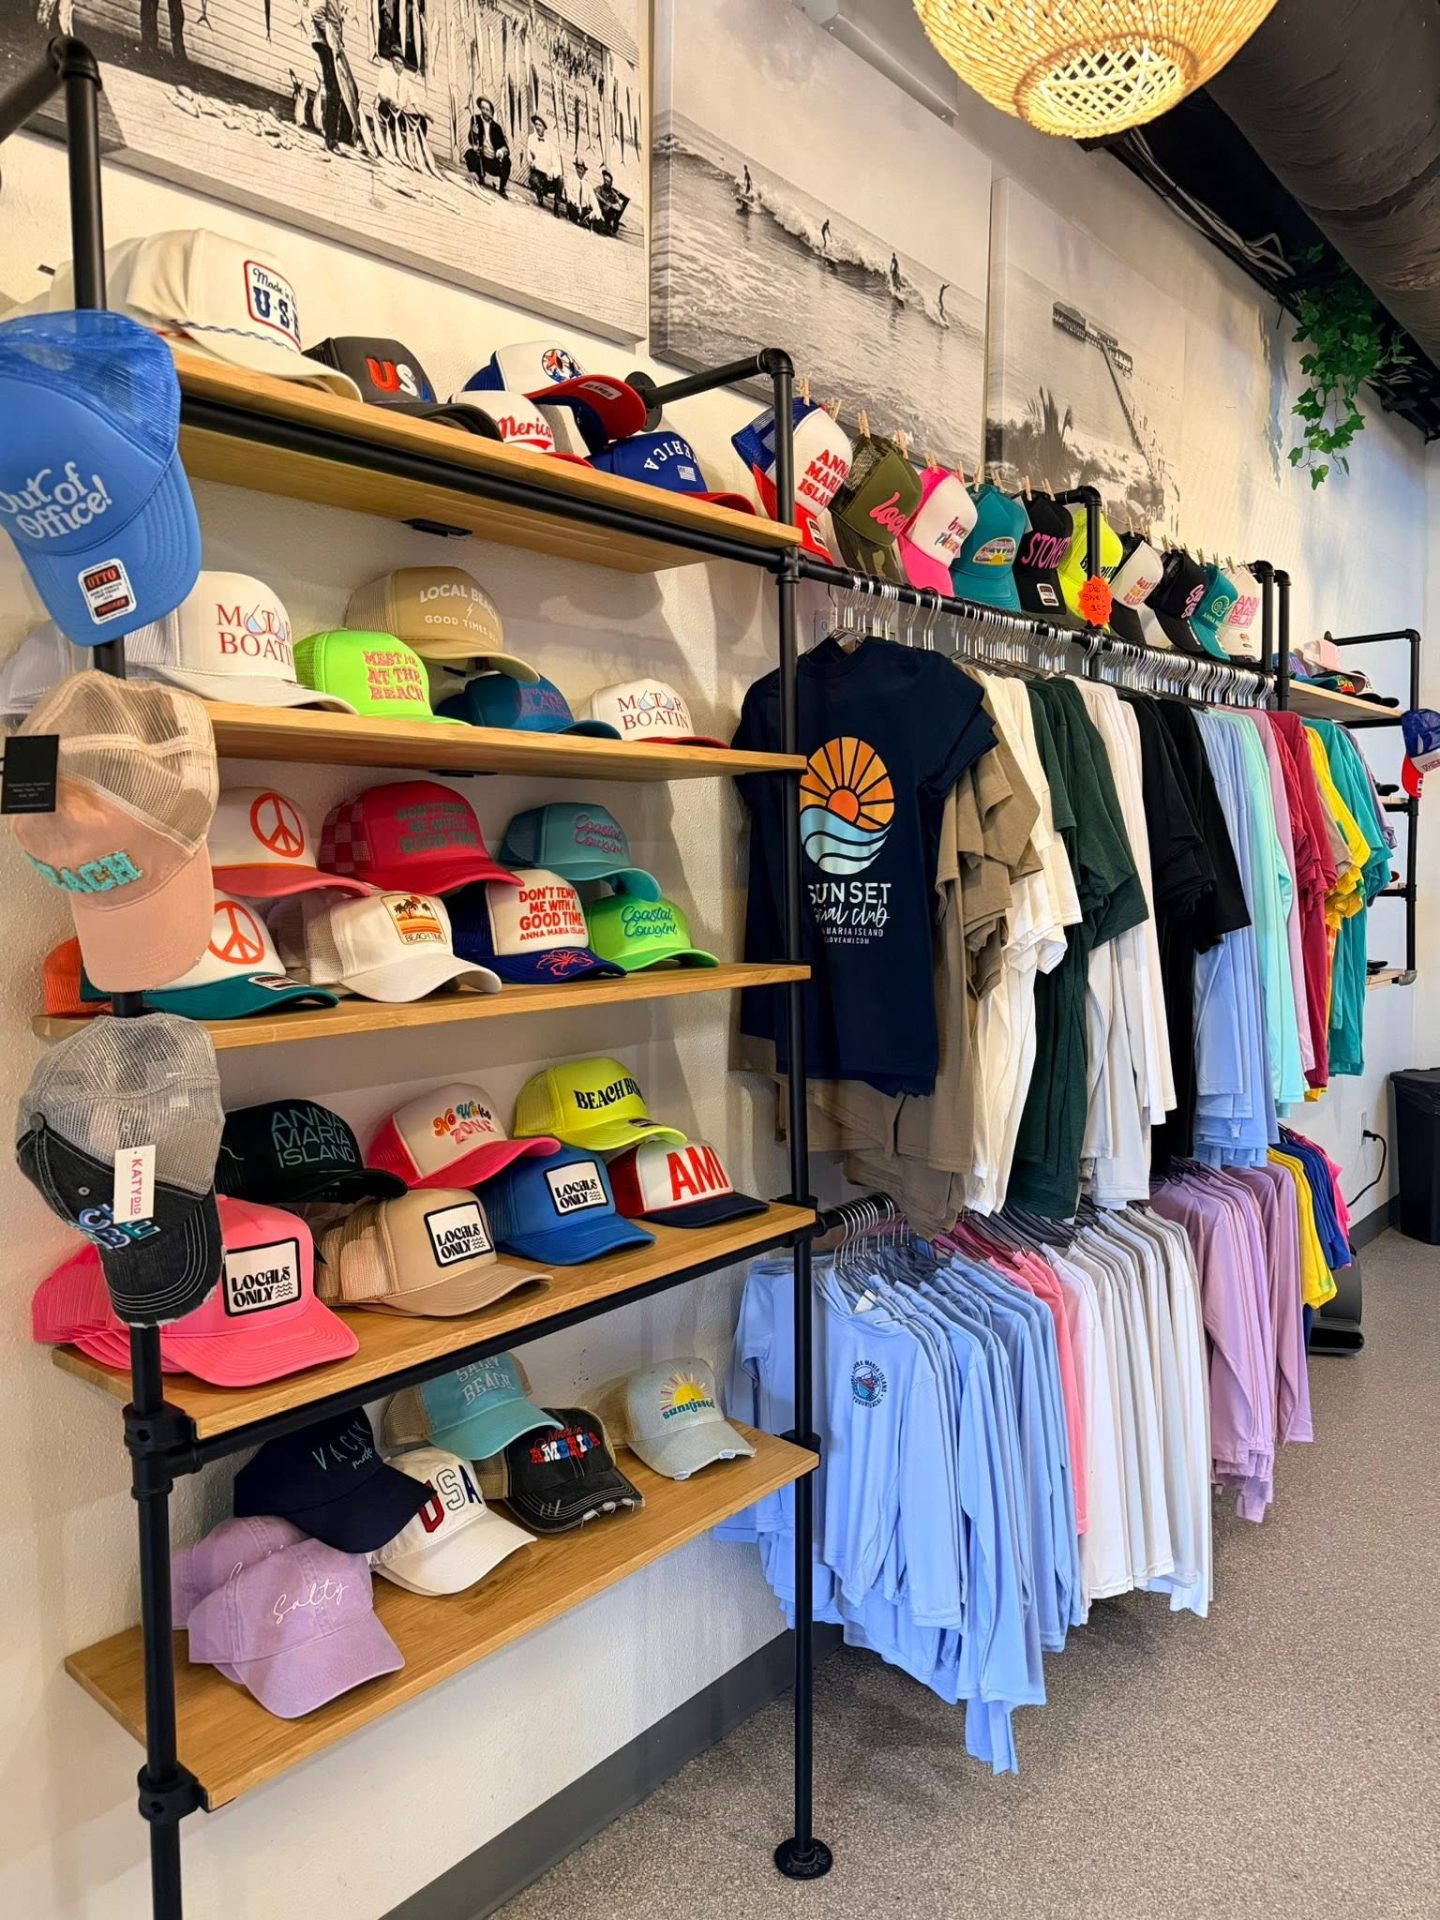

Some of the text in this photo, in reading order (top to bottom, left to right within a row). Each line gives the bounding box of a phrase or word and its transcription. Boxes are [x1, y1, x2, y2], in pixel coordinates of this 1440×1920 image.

[253, 268, 283, 295] Made
[54, 461, 88, 505] of
[16, 474, 112, 538] Office!
[86, 568, 117, 588] OTTO
[420, 584, 468, 604] LOCAL
[424, 614, 459, 626] GOOD
[368, 684, 425, 702] BEACH
[519, 886, 554, 903] DON'T
[807, 881, 892, 905] SUNSET
[529, 901, 547, 914] ME
[548, 899, 570, 912] WITH
[621, 904, 673, 925] Coastal
[851, 899, 892, 928] club
[519, 911, 583, 931] GOOD TIME
[624, 920, 678, 938] Cowgirl
[854, 926, 884, 938] ISLAND
[520, 930, 546, 941] ANNA
[573, 1079, 626, 1110] BEACH
[271, 1107, 345, 1132] ANNA
[272, 1125, 352, 1150] MARIA
[276, 1144, 357, 1169] ISLAND
[666, 1145, 729, 1202] AMI
[554, 1178, 598, 1199] LOCALS
[560, 1191, 589, 1209] ONLY
[436, 1223, 480, 1247] LOCALS
[440, 1239, 471, 1259] ONLY
[231, 1265, 291, 1293] LOCALS
[233, 1285, 274, 1308] ONLY
[461, 1371, 517, 1407] BEACH
[311, 1420, 372, 1470] VACAY
[418, 1464, 483, 1534] USA
[272, 1578, 350, 1626] Salty
